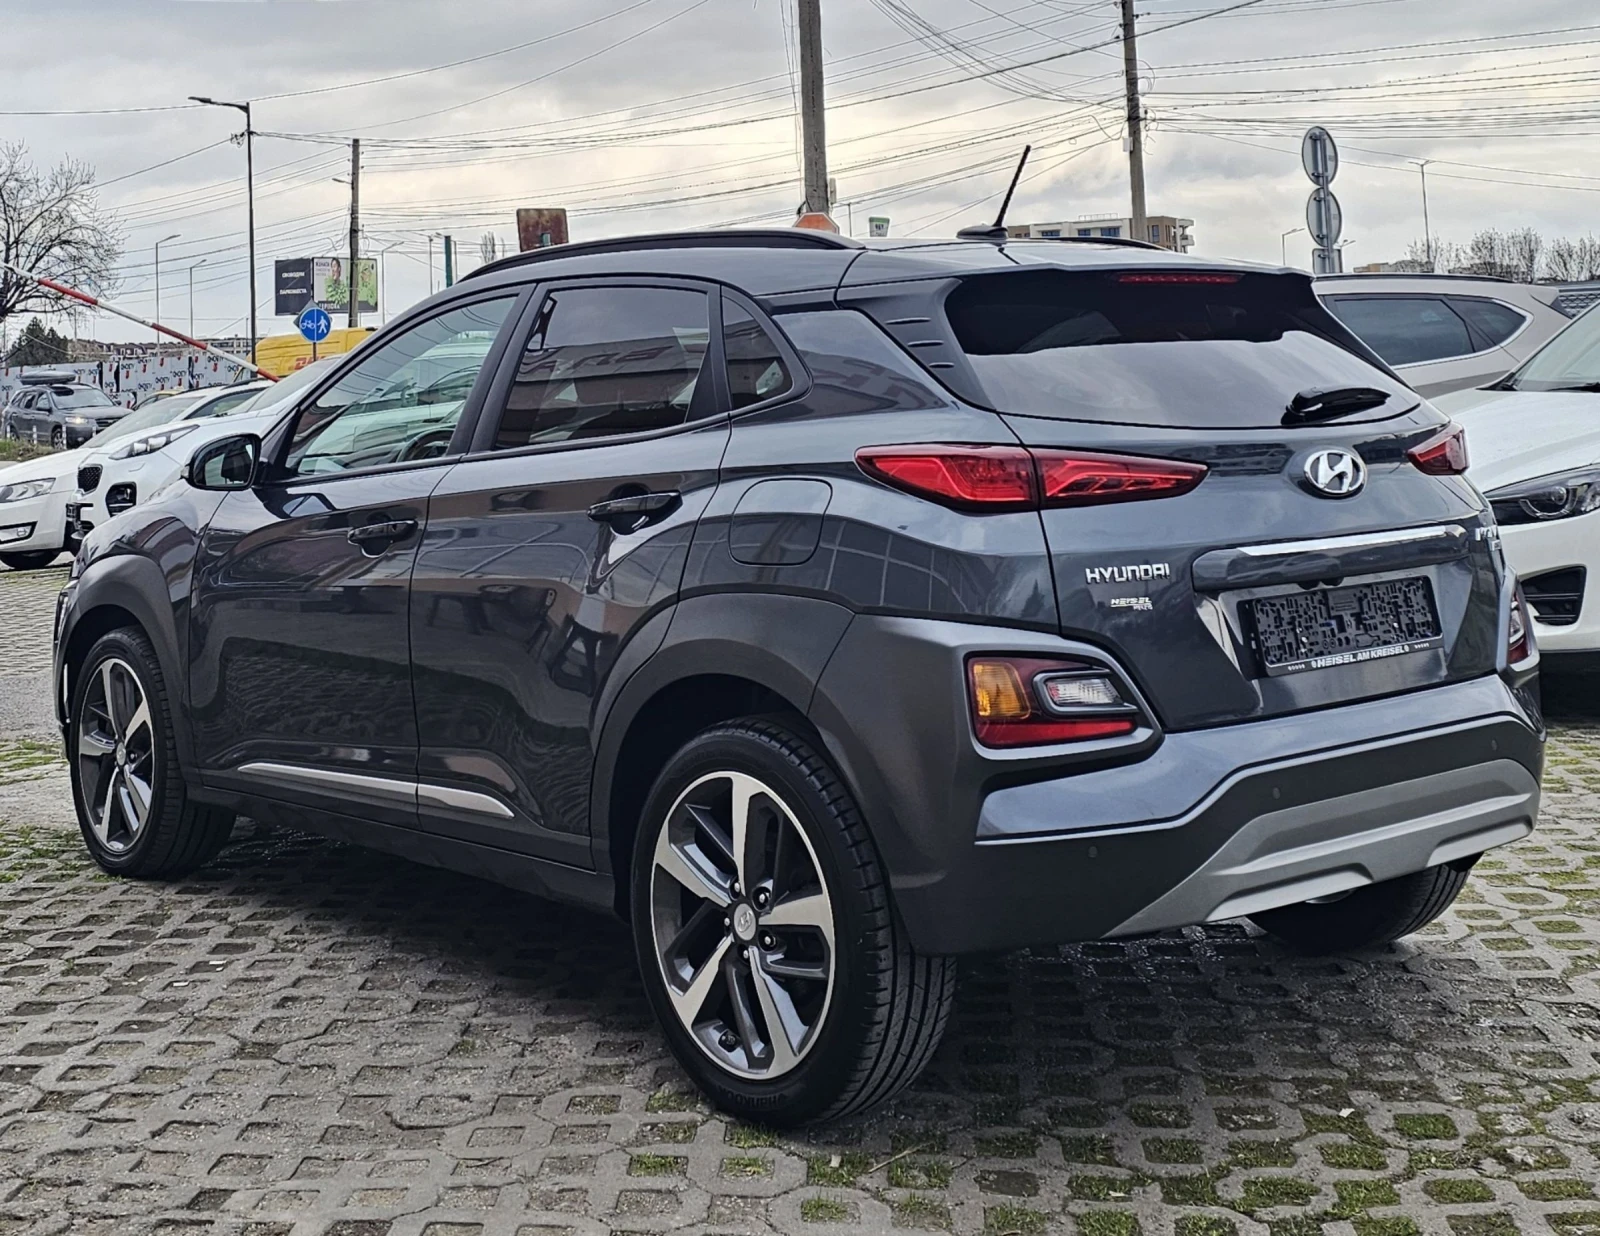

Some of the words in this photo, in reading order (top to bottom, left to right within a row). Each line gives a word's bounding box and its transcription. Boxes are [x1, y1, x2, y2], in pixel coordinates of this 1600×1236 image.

[1085, 562, 1170, 584] HYUNDAI
[1317, 654, 1356, 668] HEISEL
[1357, 650, 1370, 661] AM
[1370, 645, 1405, 659] KREISEL
